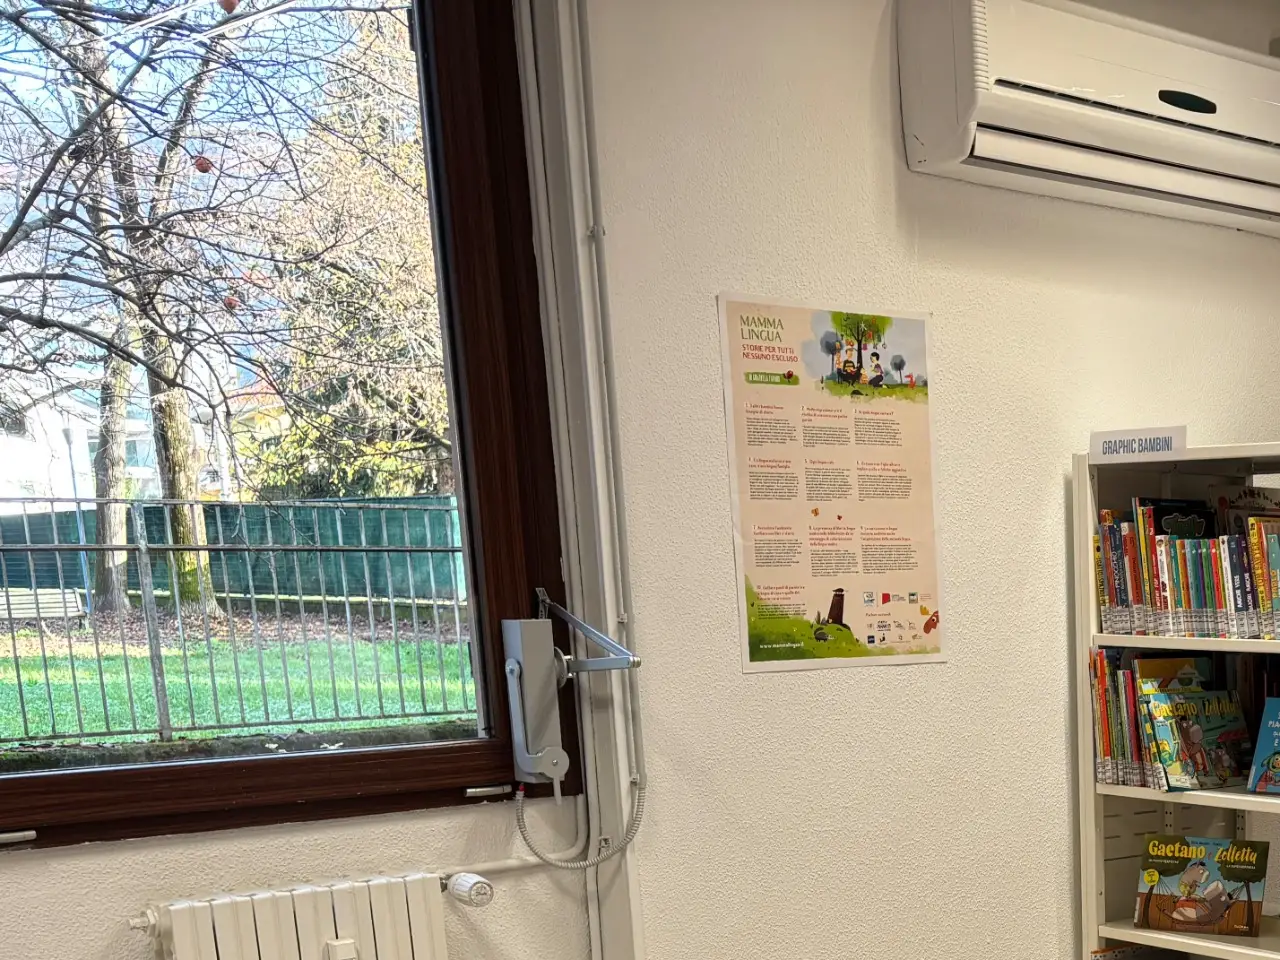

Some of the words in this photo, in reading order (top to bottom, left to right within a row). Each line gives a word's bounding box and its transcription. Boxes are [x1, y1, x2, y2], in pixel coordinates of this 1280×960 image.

[740, 314, 784, 330] MAMMA
[740, 327, 782, 342] LINGUA
[742, 343, 764, 352] STORIE
[764, 345, 776, 353] PER
[777, 346, 794, 354] TUTTI
[742, 352, 771, 361] NESSUNO
[771, 353, 799, 363] ESCLUSO
[1102, 438, 1137, 455] GRAPHIC
[1137, 436, 1173, 454] BAMBINI
[1148, 840, 1206, 859] Gaetano
[1214, 844, 1258, 864] Zolletta
